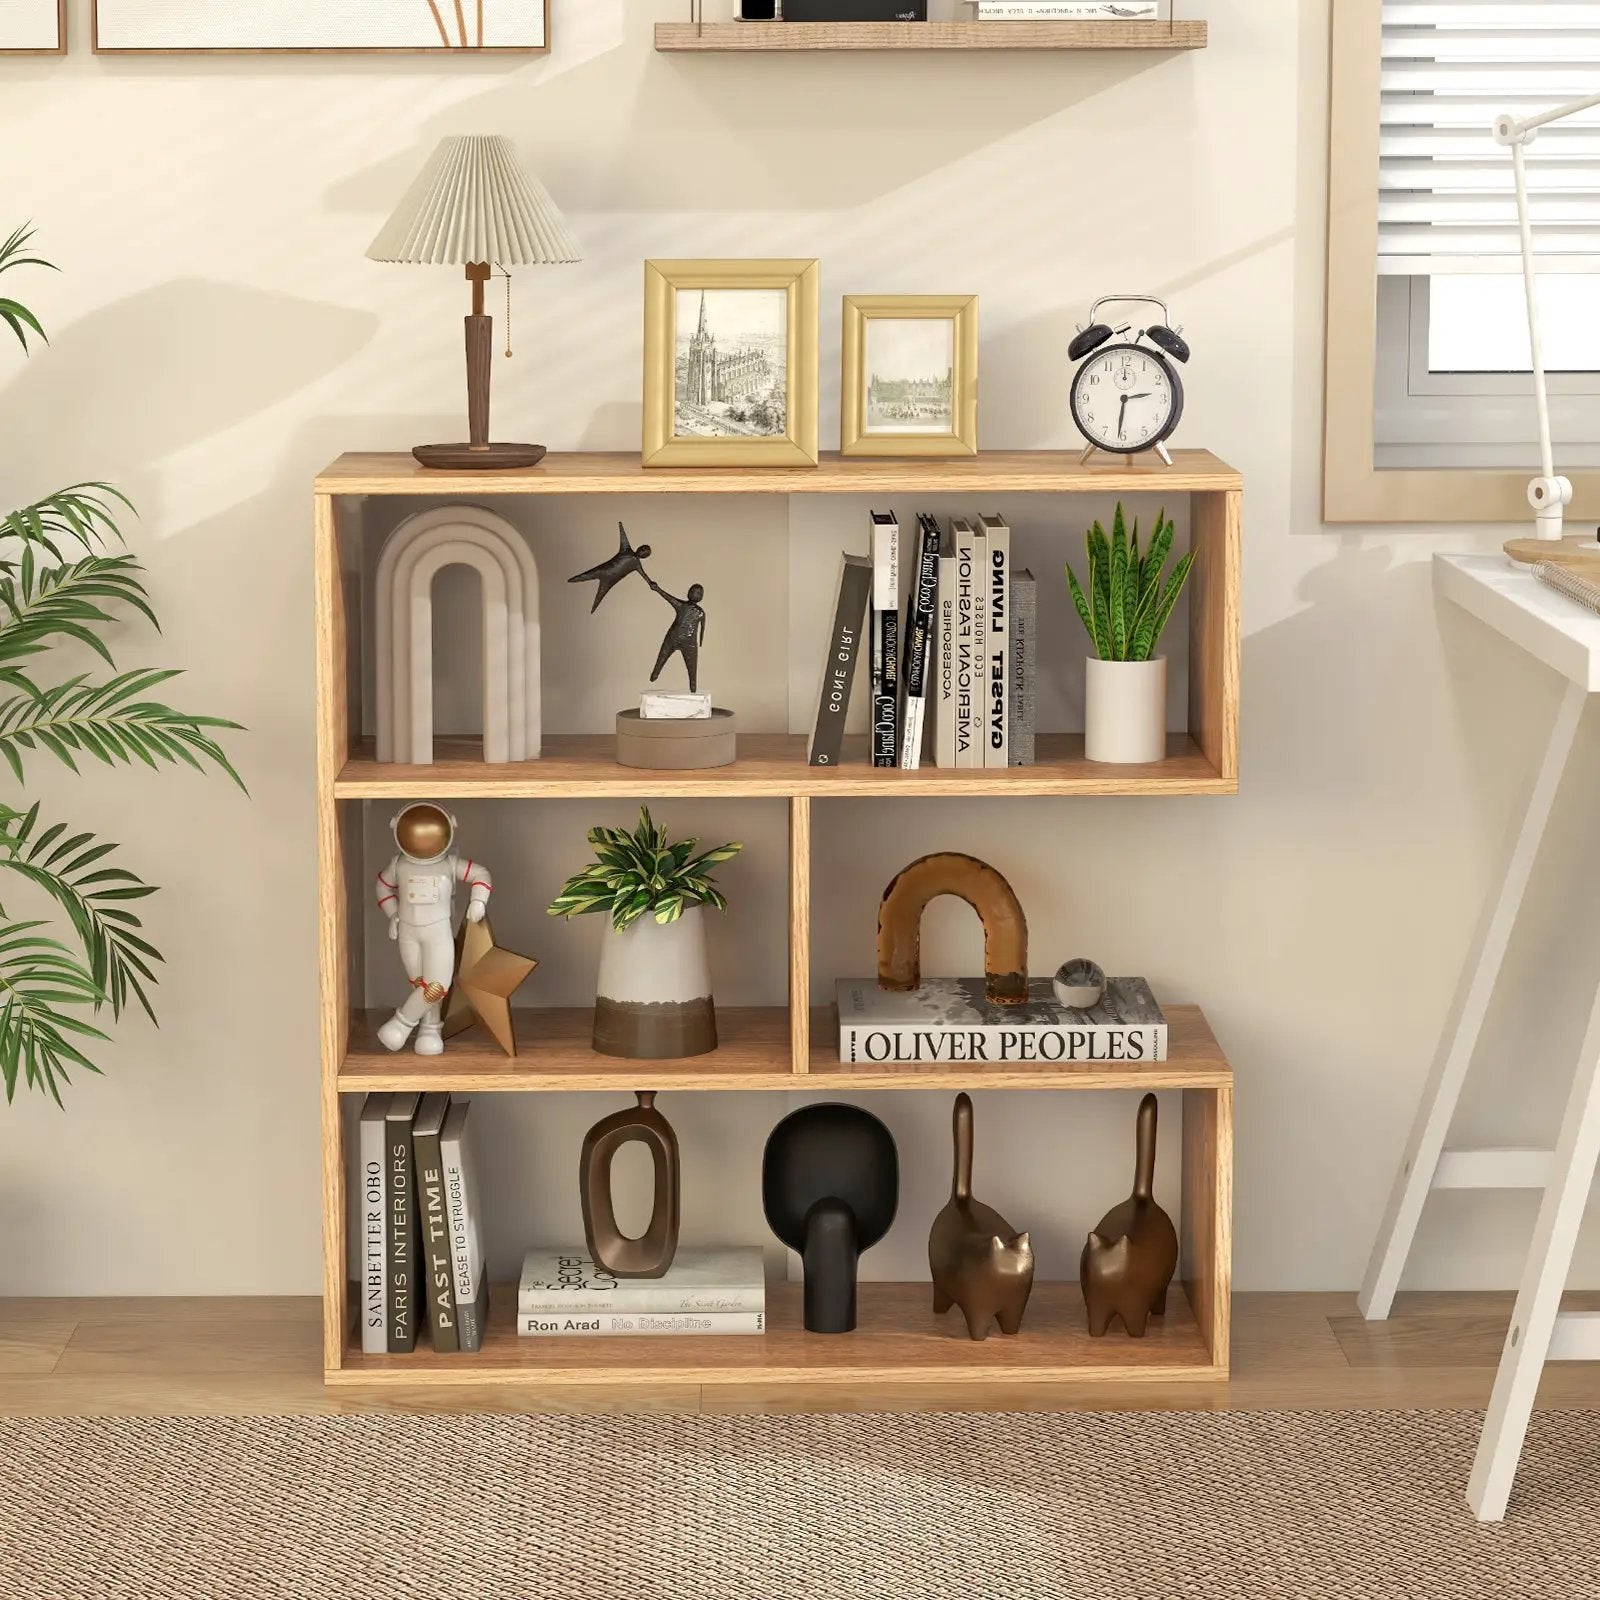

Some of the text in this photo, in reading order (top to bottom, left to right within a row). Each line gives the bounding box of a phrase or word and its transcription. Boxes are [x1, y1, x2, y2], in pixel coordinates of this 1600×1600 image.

[1104, 361, 1113, 372] 11
[1121, 356, 1131, 367] 12
[1089, 375, 1100, 385] 10
[1154, 375, 1162, 386] 2
[1082, 394, 1090, 404] 9
[1159, 394, 1167, 405] 3
[1087, 412, 1095, 423] 8
[1102, 426, 1109, 437] 7
[1119, 431, 1127, 441] 6
[1141, 426, 1148, 437] 5
[864, 1031, 989, 1062] OLIVER
[999, 1030, 1144, 1062] PEOPLES
[448, 1166, 470, 1295] CEASE TO STRUGGLE
[366, 1161, 383, 1328] SANBETTER OBO
[394, 1144, 407, 1339] PARIS INTERIORS
[425, 1168, 453, 1329] PAST TIME
[527, 1317, 713, 1332] Ron Arad No Discipline
